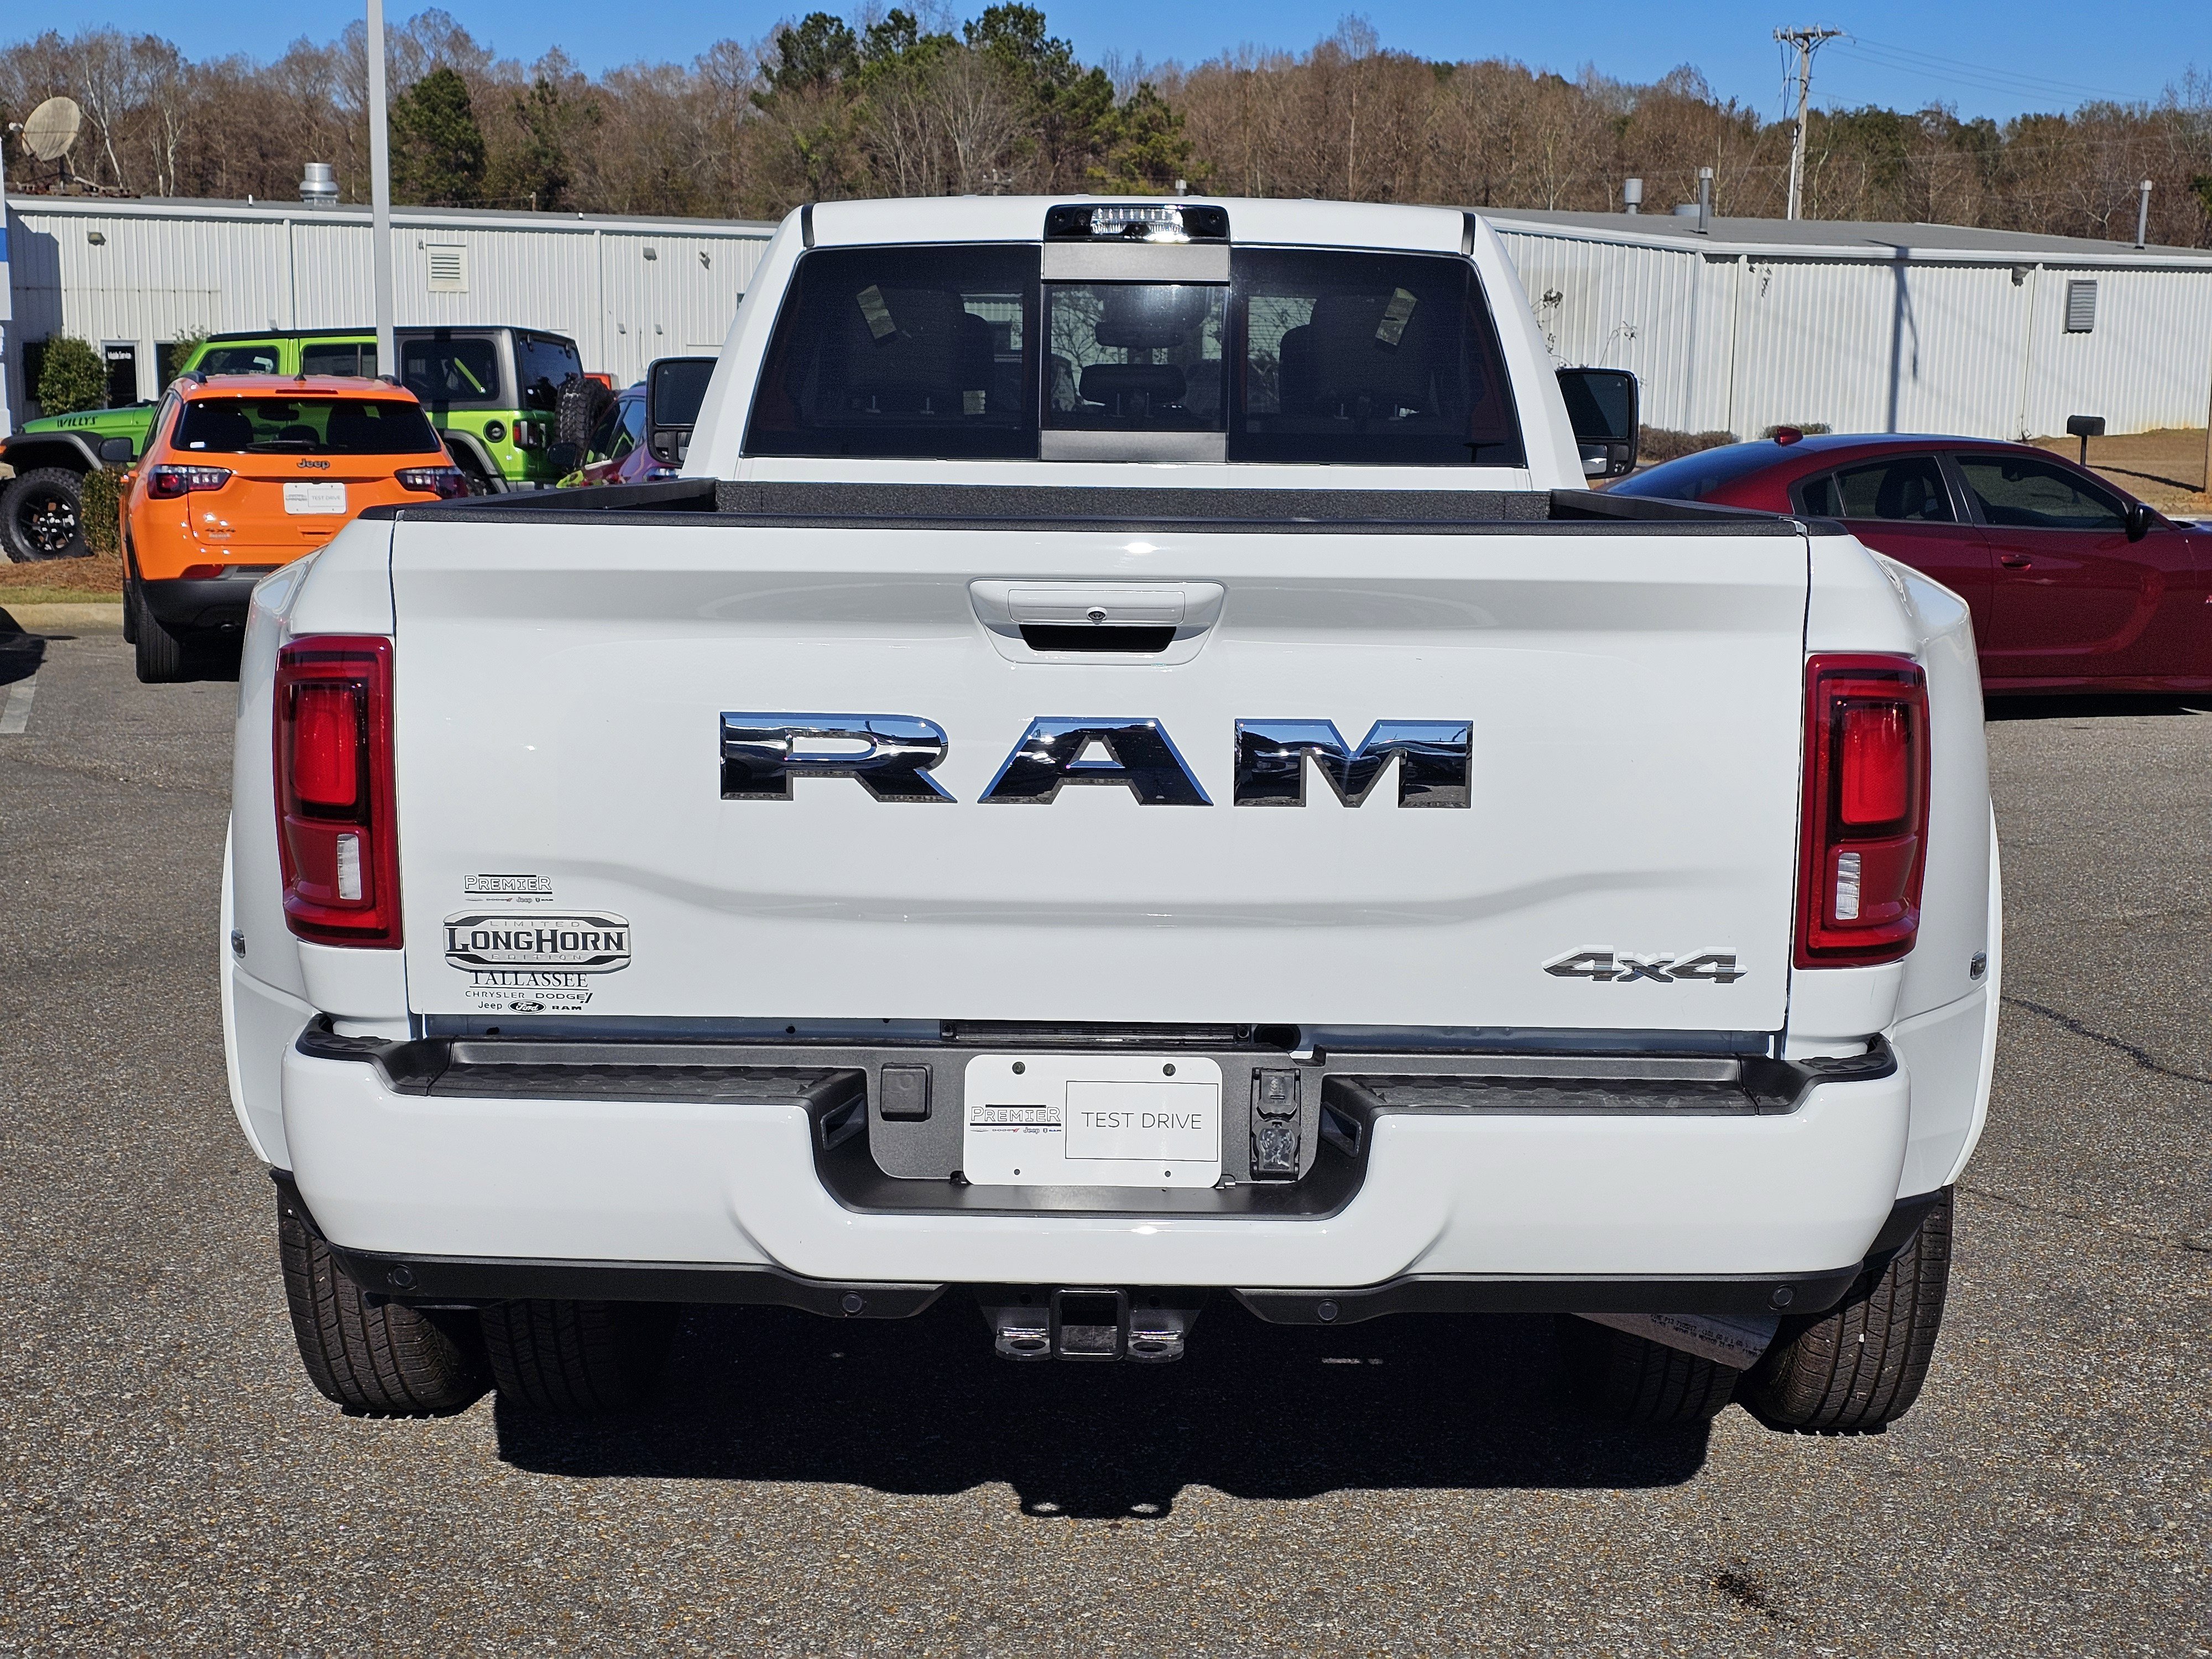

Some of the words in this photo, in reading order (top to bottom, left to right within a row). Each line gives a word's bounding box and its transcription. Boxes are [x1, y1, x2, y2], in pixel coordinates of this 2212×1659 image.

[57, 416, 98, 428] WILLYS
[296, 458, 331, 470] Jeep
[719, 711, 1474, 809] RAM
[464, 875, 552, 890] PREMIER
[470, 970, 589, 988] TALLASSEE
[465, 990, 525, 999] CHRYSLER
[535, 992, 587, 1000] DODGE
[477, 1001, 503, 1011] Jeep
[971, 1106, 1062, 1122] PREMIER
[1081, 1112, 1135, 1128] TEST
[1142, 1113, 1202, 1129] DRIVE
